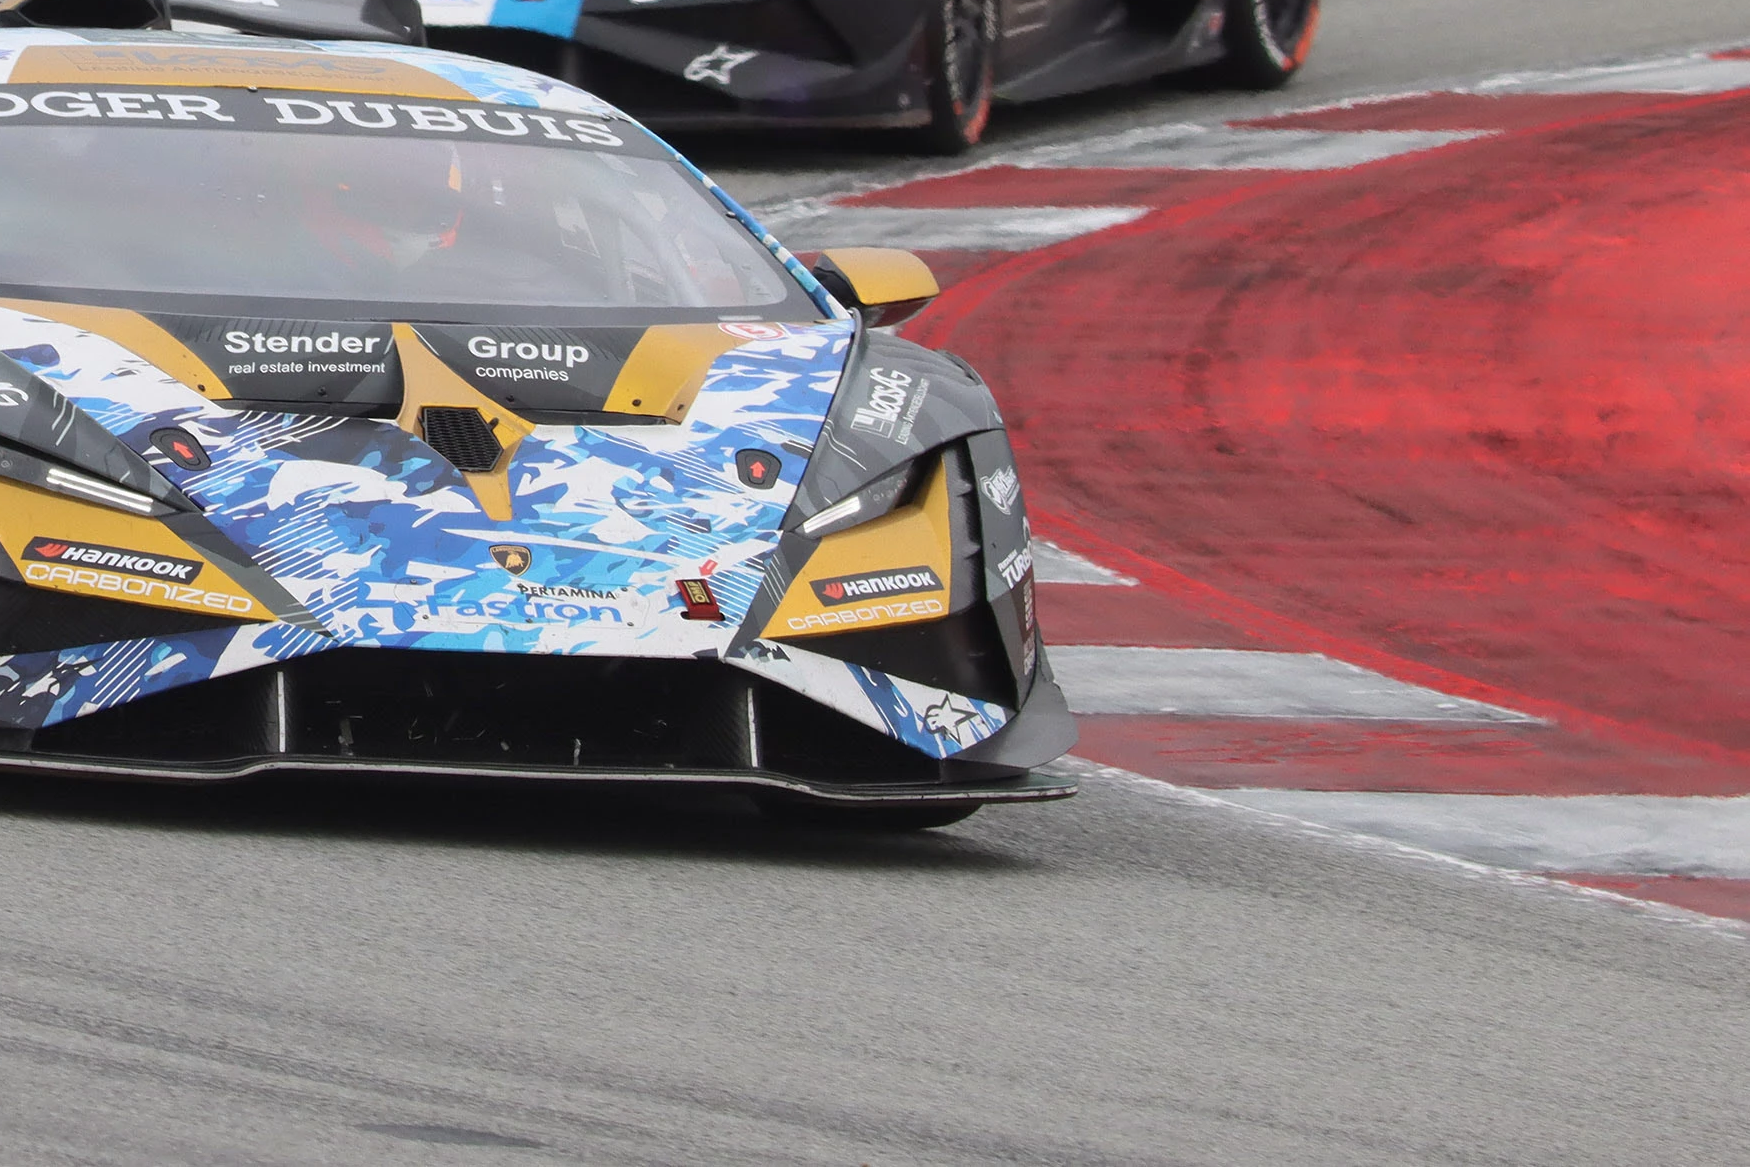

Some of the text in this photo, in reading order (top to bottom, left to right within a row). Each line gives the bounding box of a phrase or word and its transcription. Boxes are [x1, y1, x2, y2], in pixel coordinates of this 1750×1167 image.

[262, 94, 625, 147] DUBUIS
[224, 331, 381, 355] Stender
[467, 336, 590, 368] Group
[229, 361, 386, 374] real estate investment
[475, 365, 570, 382] companies
[25, 563, 253, 613] CARBONIZED
[518, 583, 617, 600] PERTAMINA
[427, 594, 623, 624] Fastron
[787, 599, 944, 631] CARBONIZED
